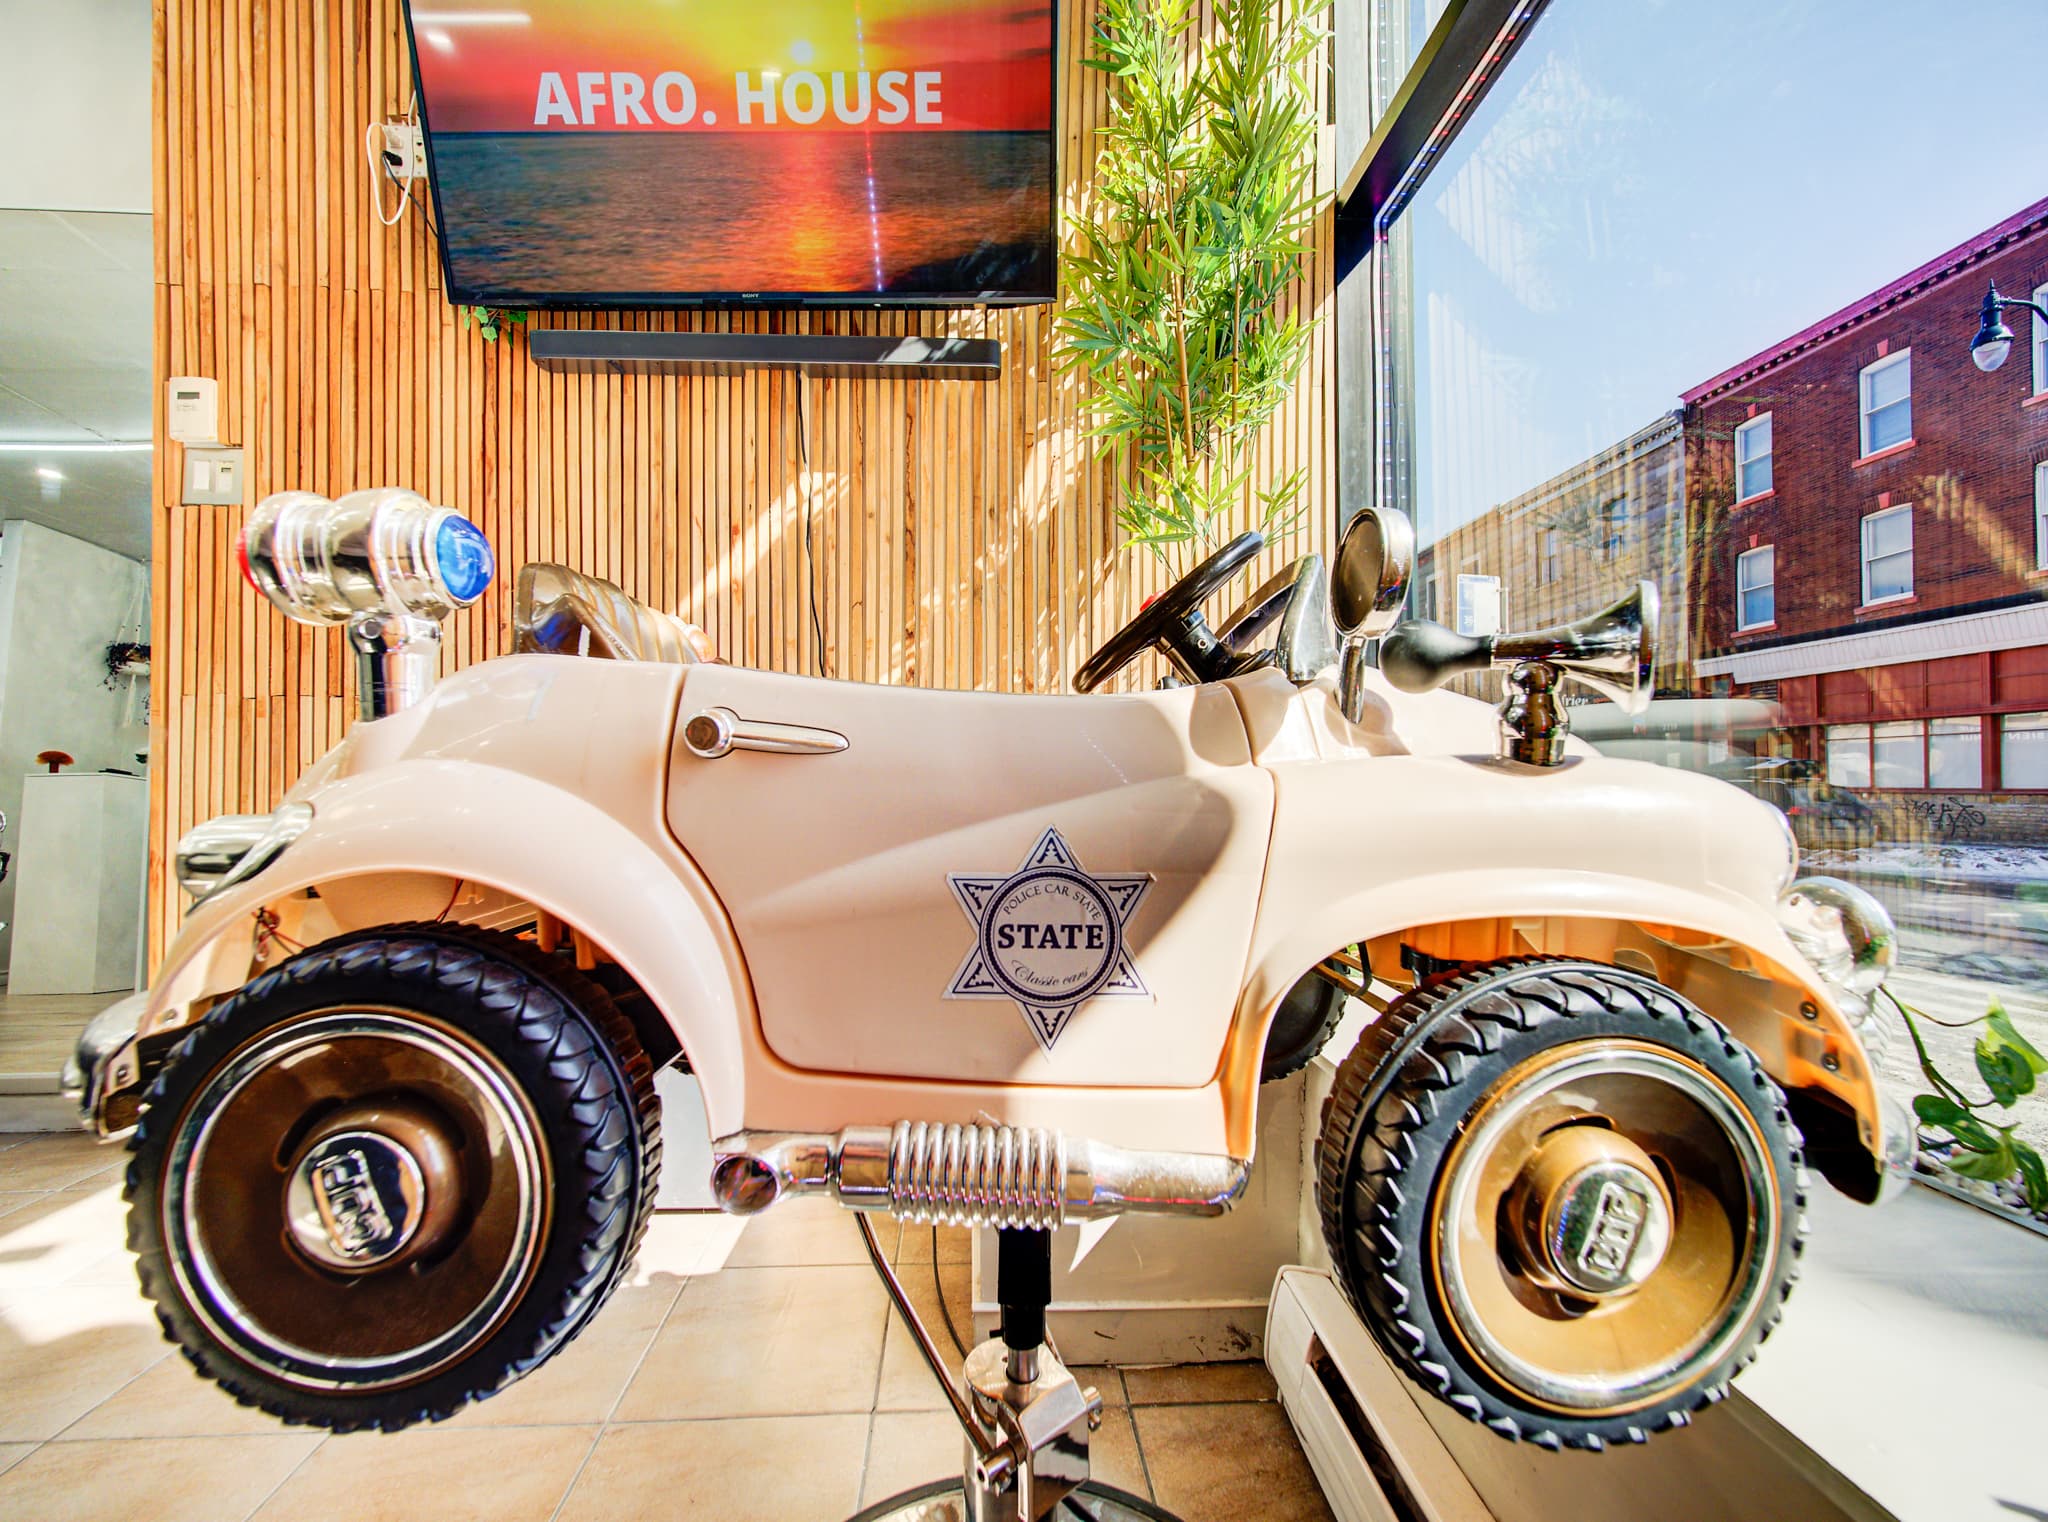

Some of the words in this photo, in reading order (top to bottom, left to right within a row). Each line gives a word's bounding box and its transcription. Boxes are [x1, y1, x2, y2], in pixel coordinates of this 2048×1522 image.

[534, 71, 716, 125] AFRO.
[735, 71, 942, 125] HOUSE
[1003, 885, 1042, 915] POLICE
[1044, 883, 1069, 897] CAR
[1072, 891, 1102, 921] STATE
[997, 923, 1105, 950] STATE
[1011, 959, 1060, 986] Classic
